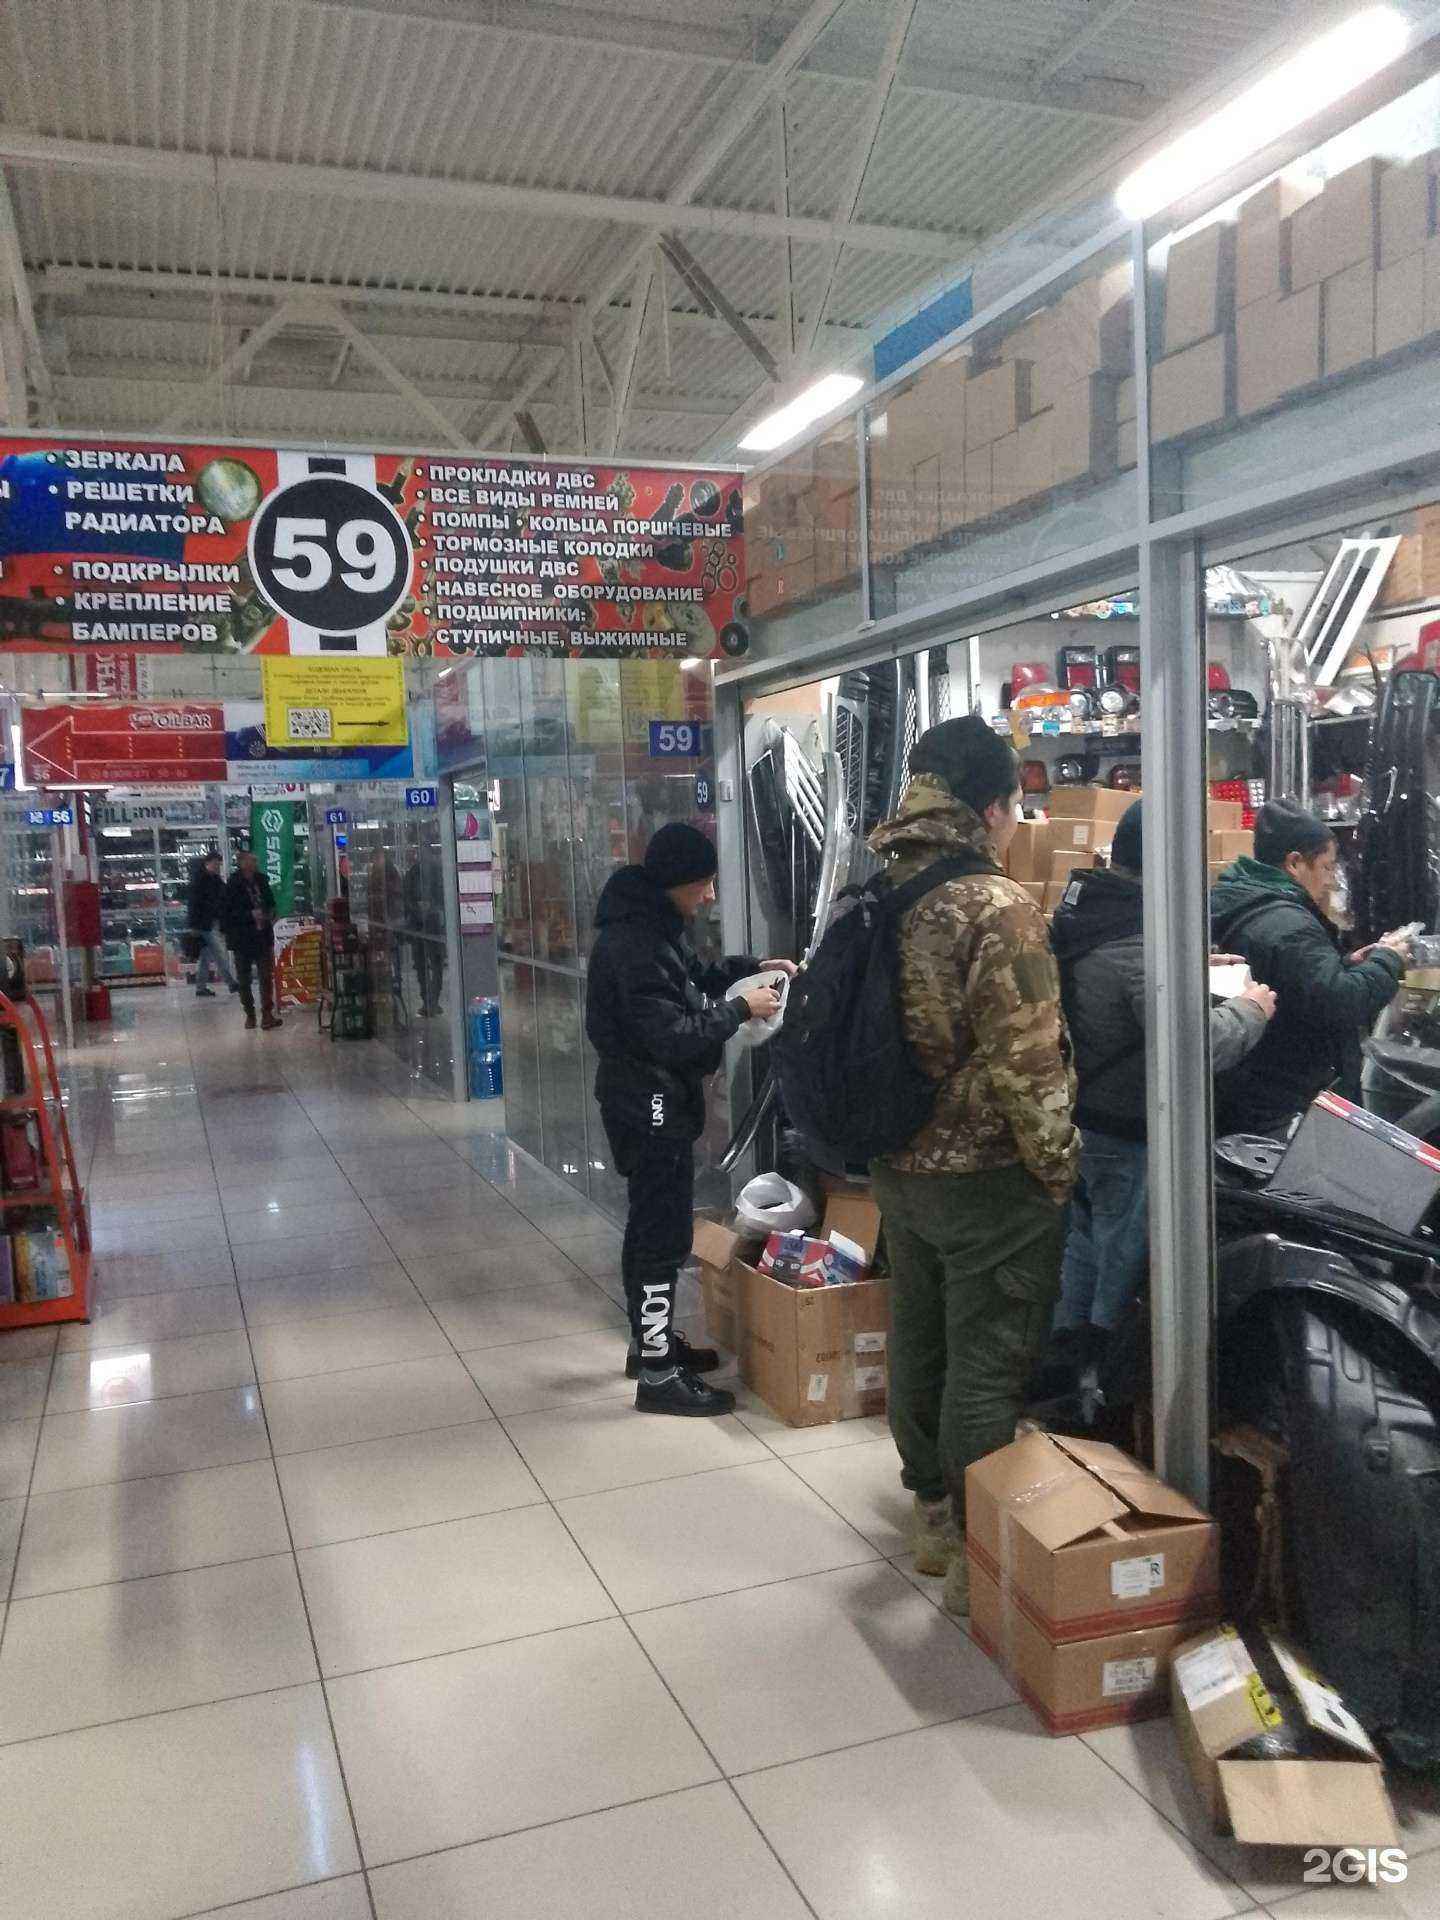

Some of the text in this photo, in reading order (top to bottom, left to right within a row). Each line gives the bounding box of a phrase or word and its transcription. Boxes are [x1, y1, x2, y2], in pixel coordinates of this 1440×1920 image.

[65, 451, 186, 473] ЗЕРКАЛА
[429, 465, 596, 489] ПРОКЛАДКИ ДВС
[67, 481, 194, 503] РЕШЕТКИ
[430, 488, 619, 511] ВСЕ ВИДЫ РЕМНЕЙ
[65, 512, 226, 535] РАДИАТОРА
[431, 512, 732, 537] ПОМПЫ КОЛЬЦА ПОРШНЕВЫЕ
[271, 516, 397, 594] 59
[432, 535, 654, 559] ТОРМОЗНЫЕ КОЛОДКИ
[72, 561, 240, 583] ПОДКРЫЛКИ
[435, 557, 580, 577] ПОДУШКИ ДВС
[74, 593, 232, 613] КРЕПЛЕНИЕ
[436, 582, 704, 602] НАВЕСНОЕ ОБОРУДОВАНИЕ
[437, 605, 586, 623] ПОДШИПНИКИ:
[72, 623, 218, 642] БАМПЕРОВ
[436, 629, 689, 647] СТУПИЧНЫЕ, ВЫЖИМНЫЕ
[658, 725, 693, 751] 59
[410, 789, 430, 806] 60
[697, 781, 708, 804] 59
[52, 810, 71, 823] 56
[330, 812, 343, 823] 61
[266, 835, 282, 887] SATA
